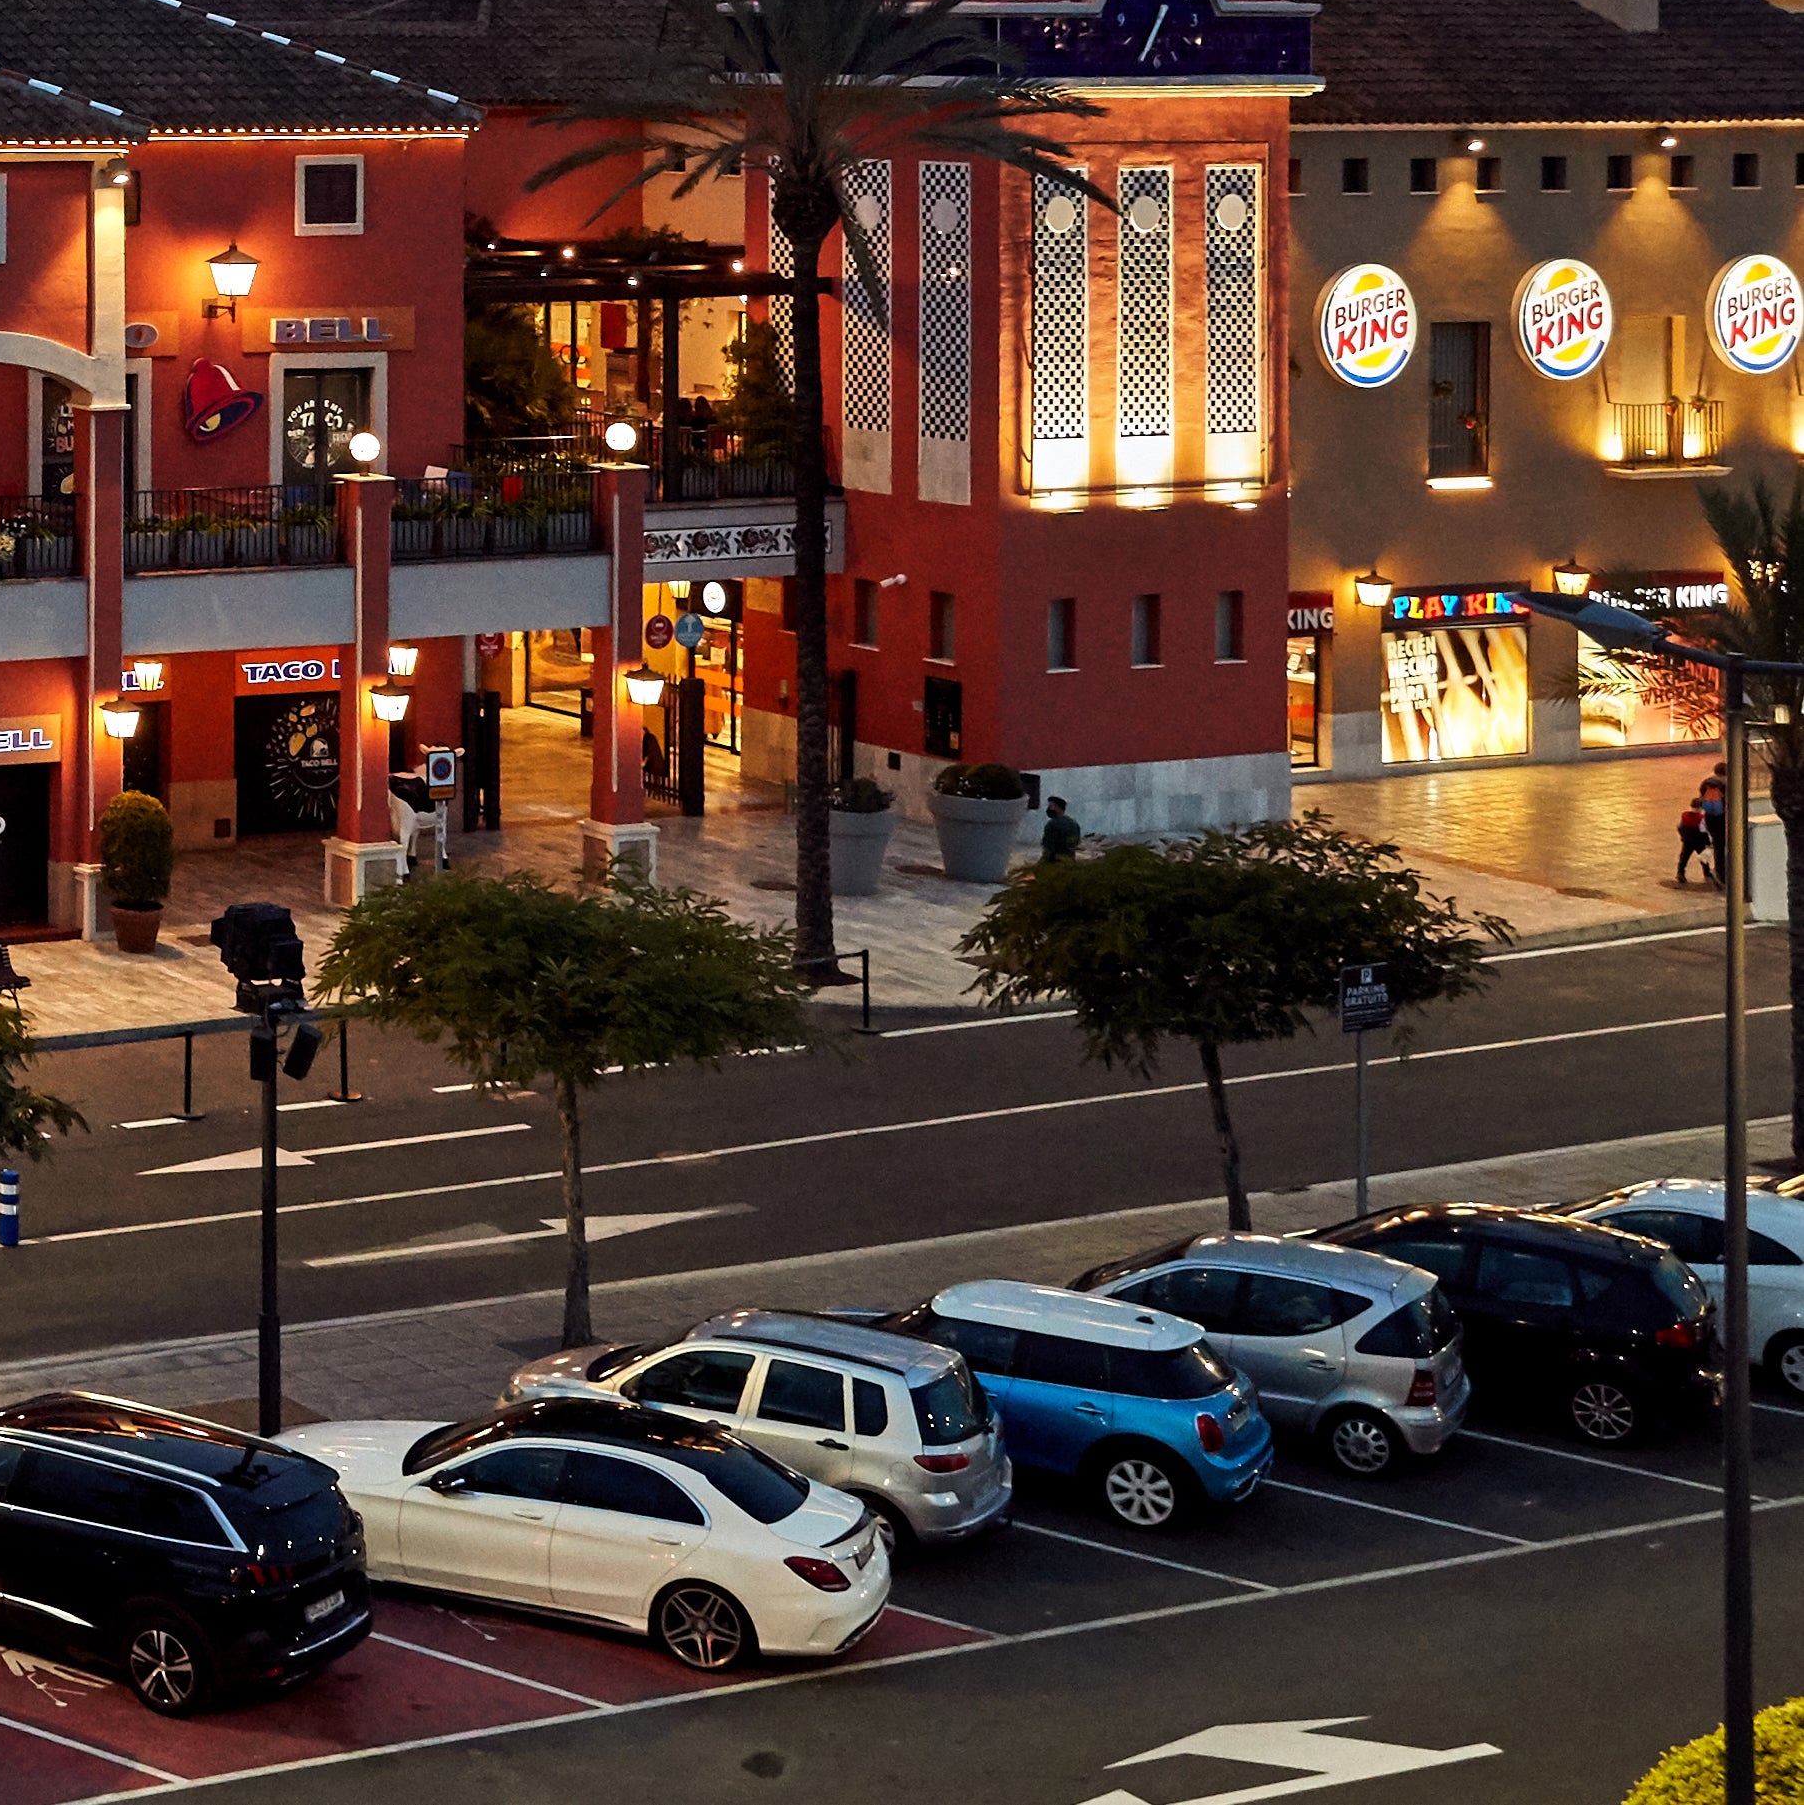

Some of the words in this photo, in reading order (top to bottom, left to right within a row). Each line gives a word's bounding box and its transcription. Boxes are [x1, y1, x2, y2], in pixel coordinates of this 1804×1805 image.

[1117, 12, 1126, 27] 9
[1190, 13, 1199, 27] 3
[1153, 54, 1162, 69] 6
[1335, 288, 1406, 329] BURGER
[1531, 280, 1600, 327] BURGER
[1727, 277, 1793, 319] BURGER
[270, 317, 392, 343] BELL
[1336, 310, 1409, 360] KING
[1535, 301, 1603, 356] KING
[1729, 297, 1795, 349] KING
[287, 405, 302, 423] YOU
[330, 403, 343, 414] MY
[1392, 594, 1459, 620] PLAY
[1675, 583, 1728, 608] KING
[242, 659, 327, 683] TACO
[1344, 992, 1389, 1007] GRATUITO
[1346, 983, 1387, 997] PARKING
